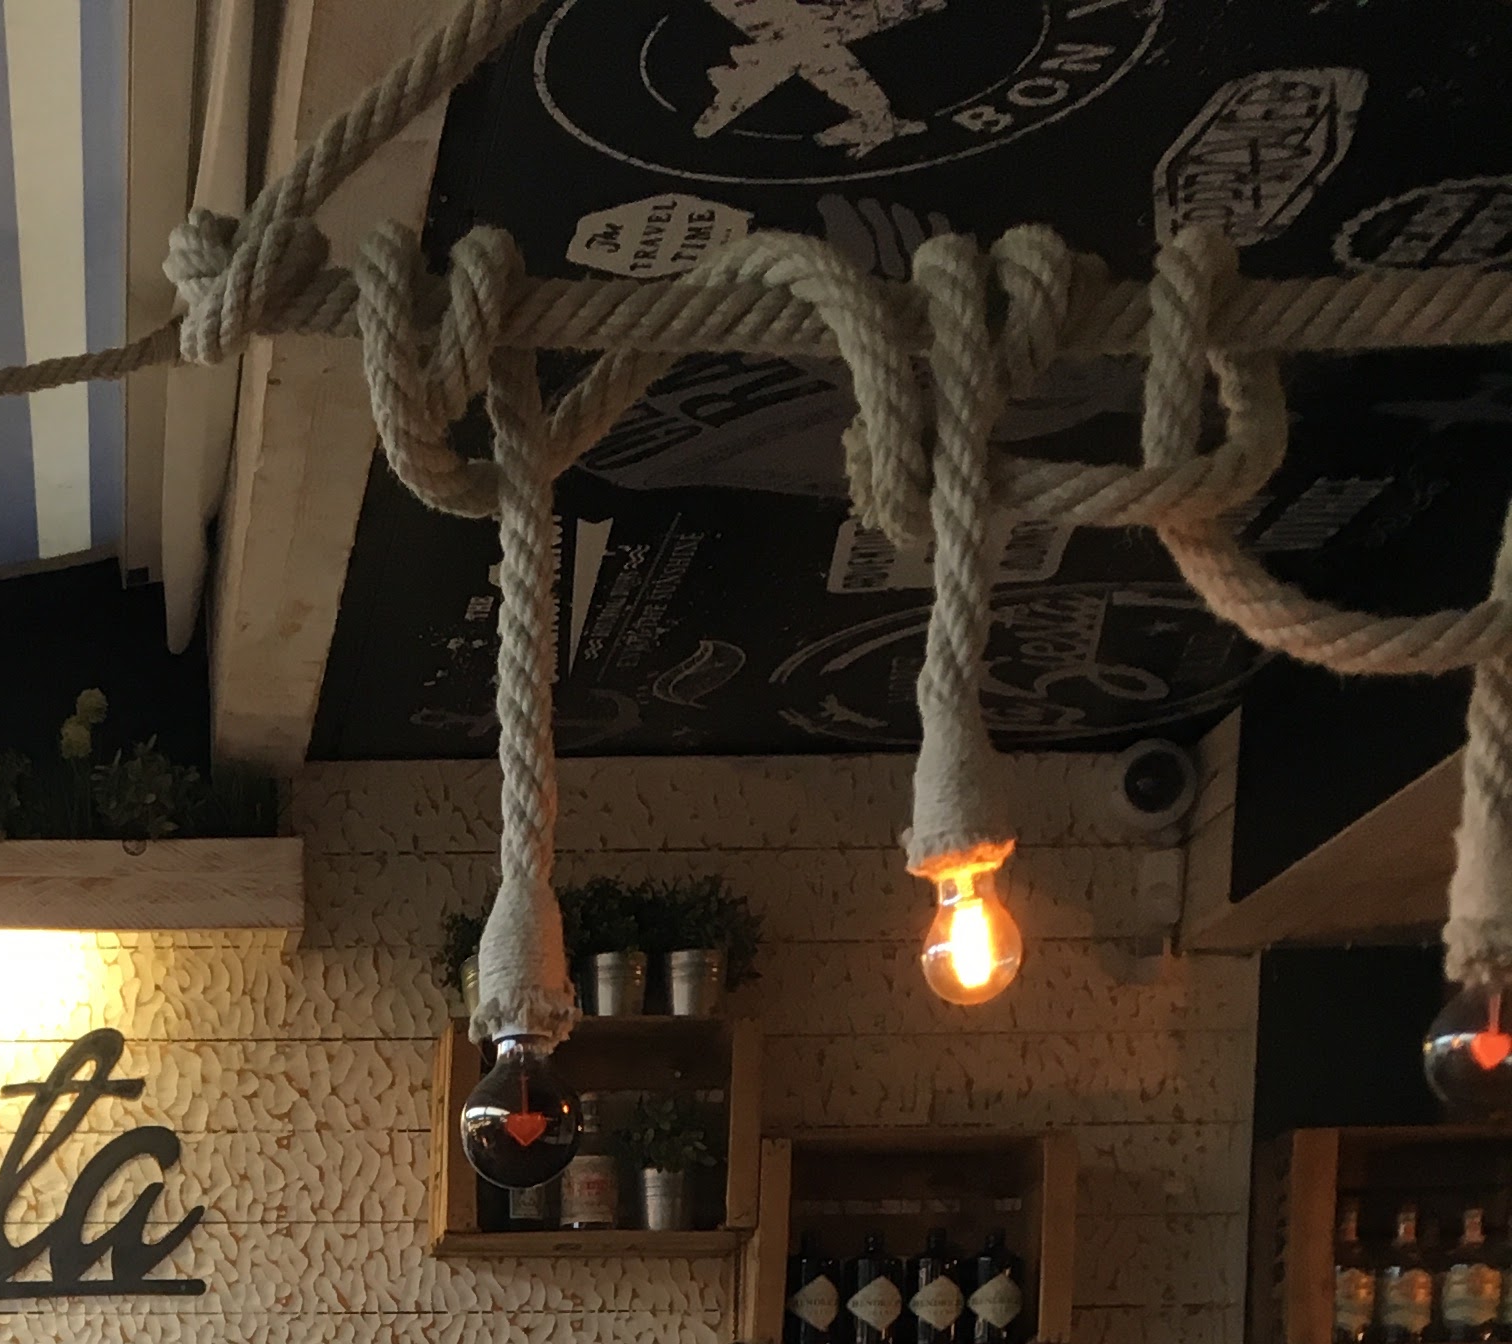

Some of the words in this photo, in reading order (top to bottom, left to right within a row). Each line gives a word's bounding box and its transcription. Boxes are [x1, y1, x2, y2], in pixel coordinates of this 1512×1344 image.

[950, 41, 1117, 134] BON
[629, 199, 678, 271] TRAVEL
[670, 208, 716, 262] TIME
